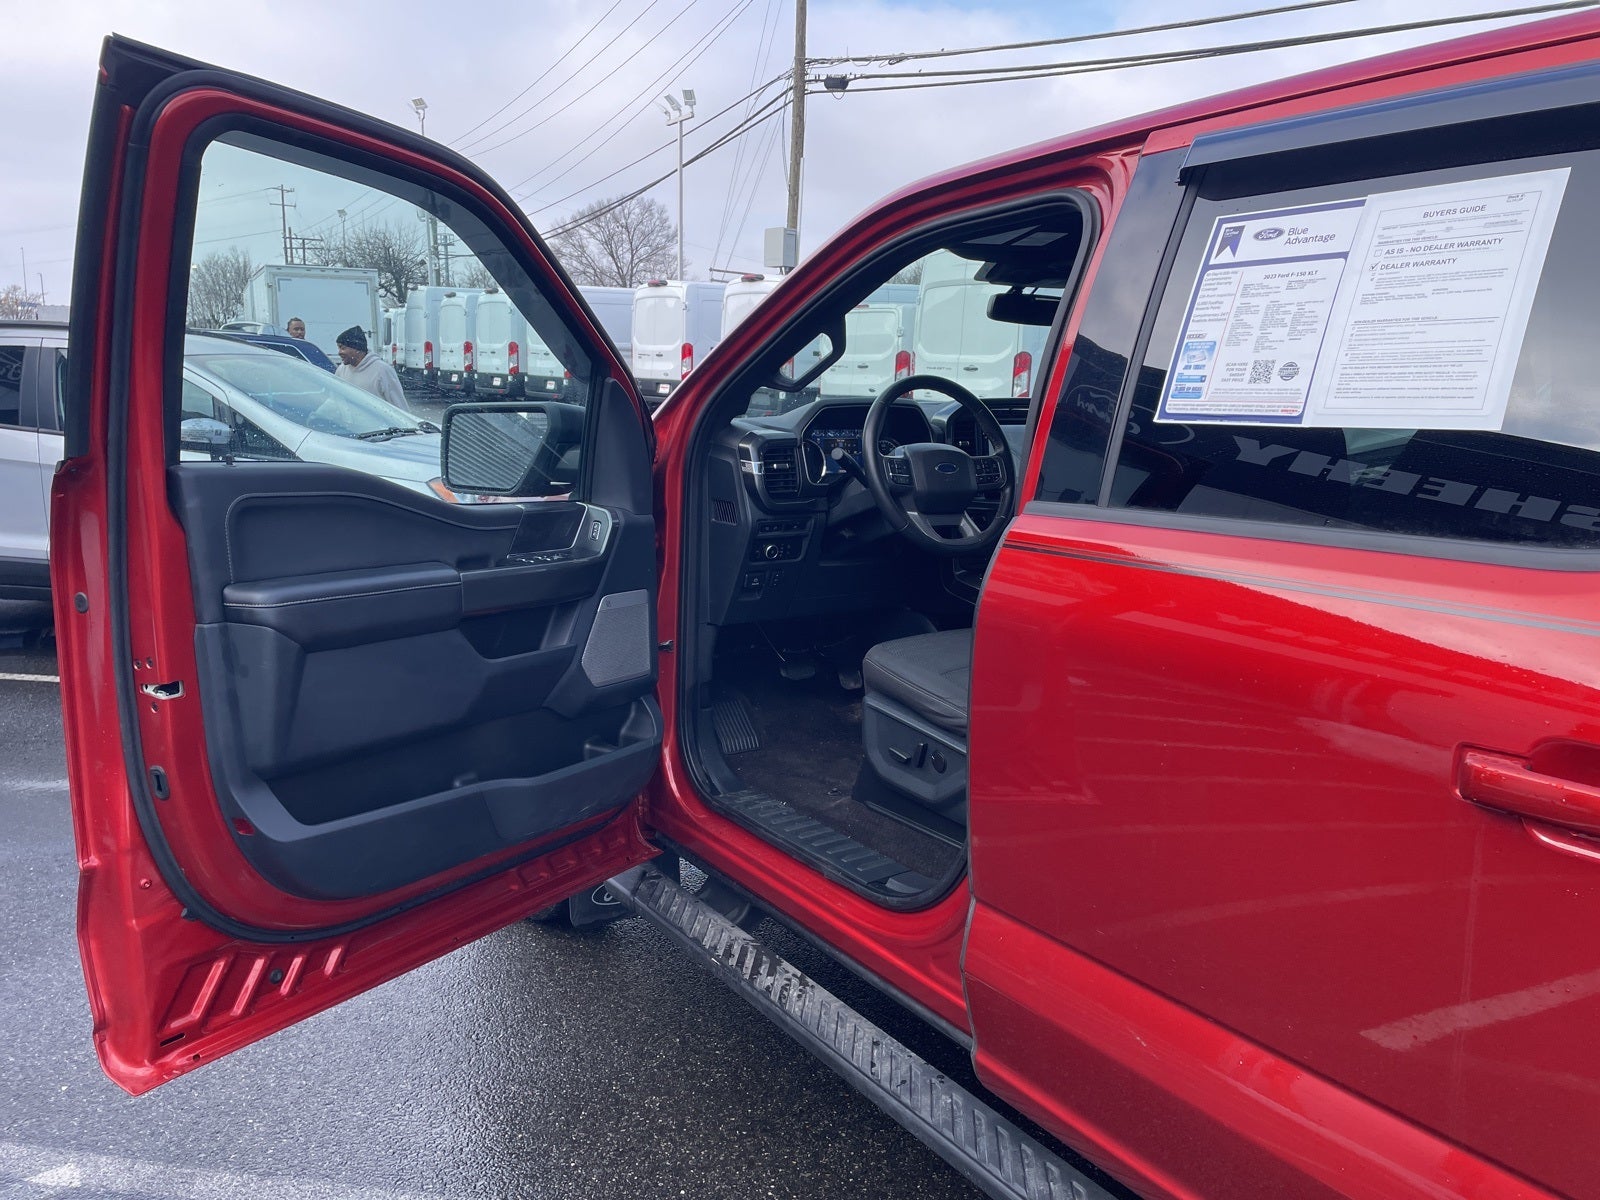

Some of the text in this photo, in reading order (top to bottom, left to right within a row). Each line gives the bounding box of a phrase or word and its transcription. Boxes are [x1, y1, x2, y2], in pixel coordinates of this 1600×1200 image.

[1423, 208, 1458, 218] BUYERS
[1459, 204, 1487, 214] GUIDE
[1287, 226, 1310, 236] Blue
[1284, 232, 1337, 247] Advantage
[1423, 243, 1456, 251] DEALER
[1456, 237, 1504, 248] WARRANTY
[1380, 258, 1457, 270] DEALER WARRANTY
